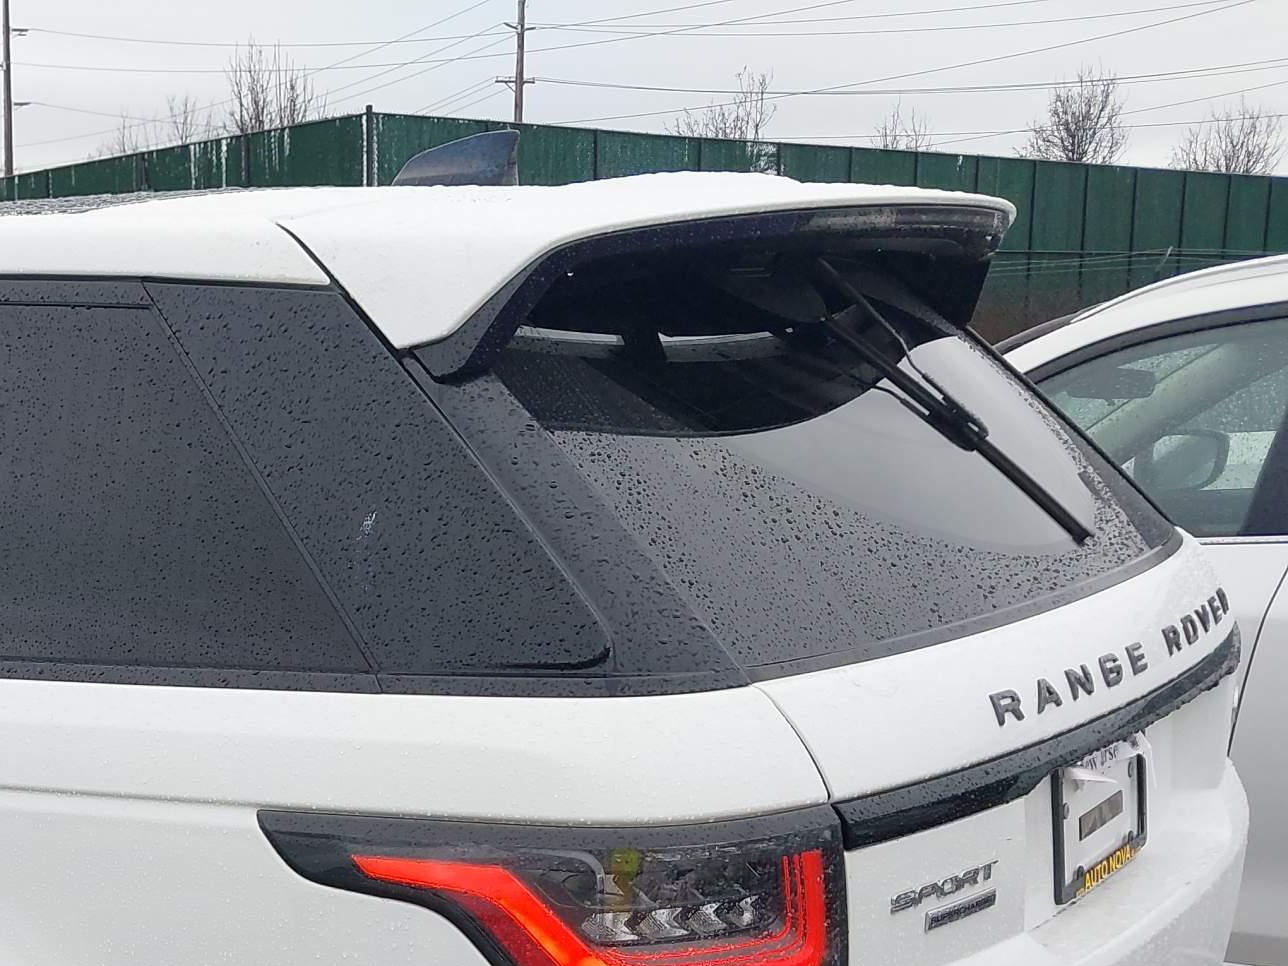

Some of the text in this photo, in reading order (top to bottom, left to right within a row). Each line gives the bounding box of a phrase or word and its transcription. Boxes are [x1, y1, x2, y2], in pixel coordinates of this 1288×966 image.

[988, 586, 1230, 727] RANGE ROVER
[890, 859, 999, 914] SPORT
[1084, 860, 1108, 892] AUTO
[1109, 843, 1131, 874] NOVA
